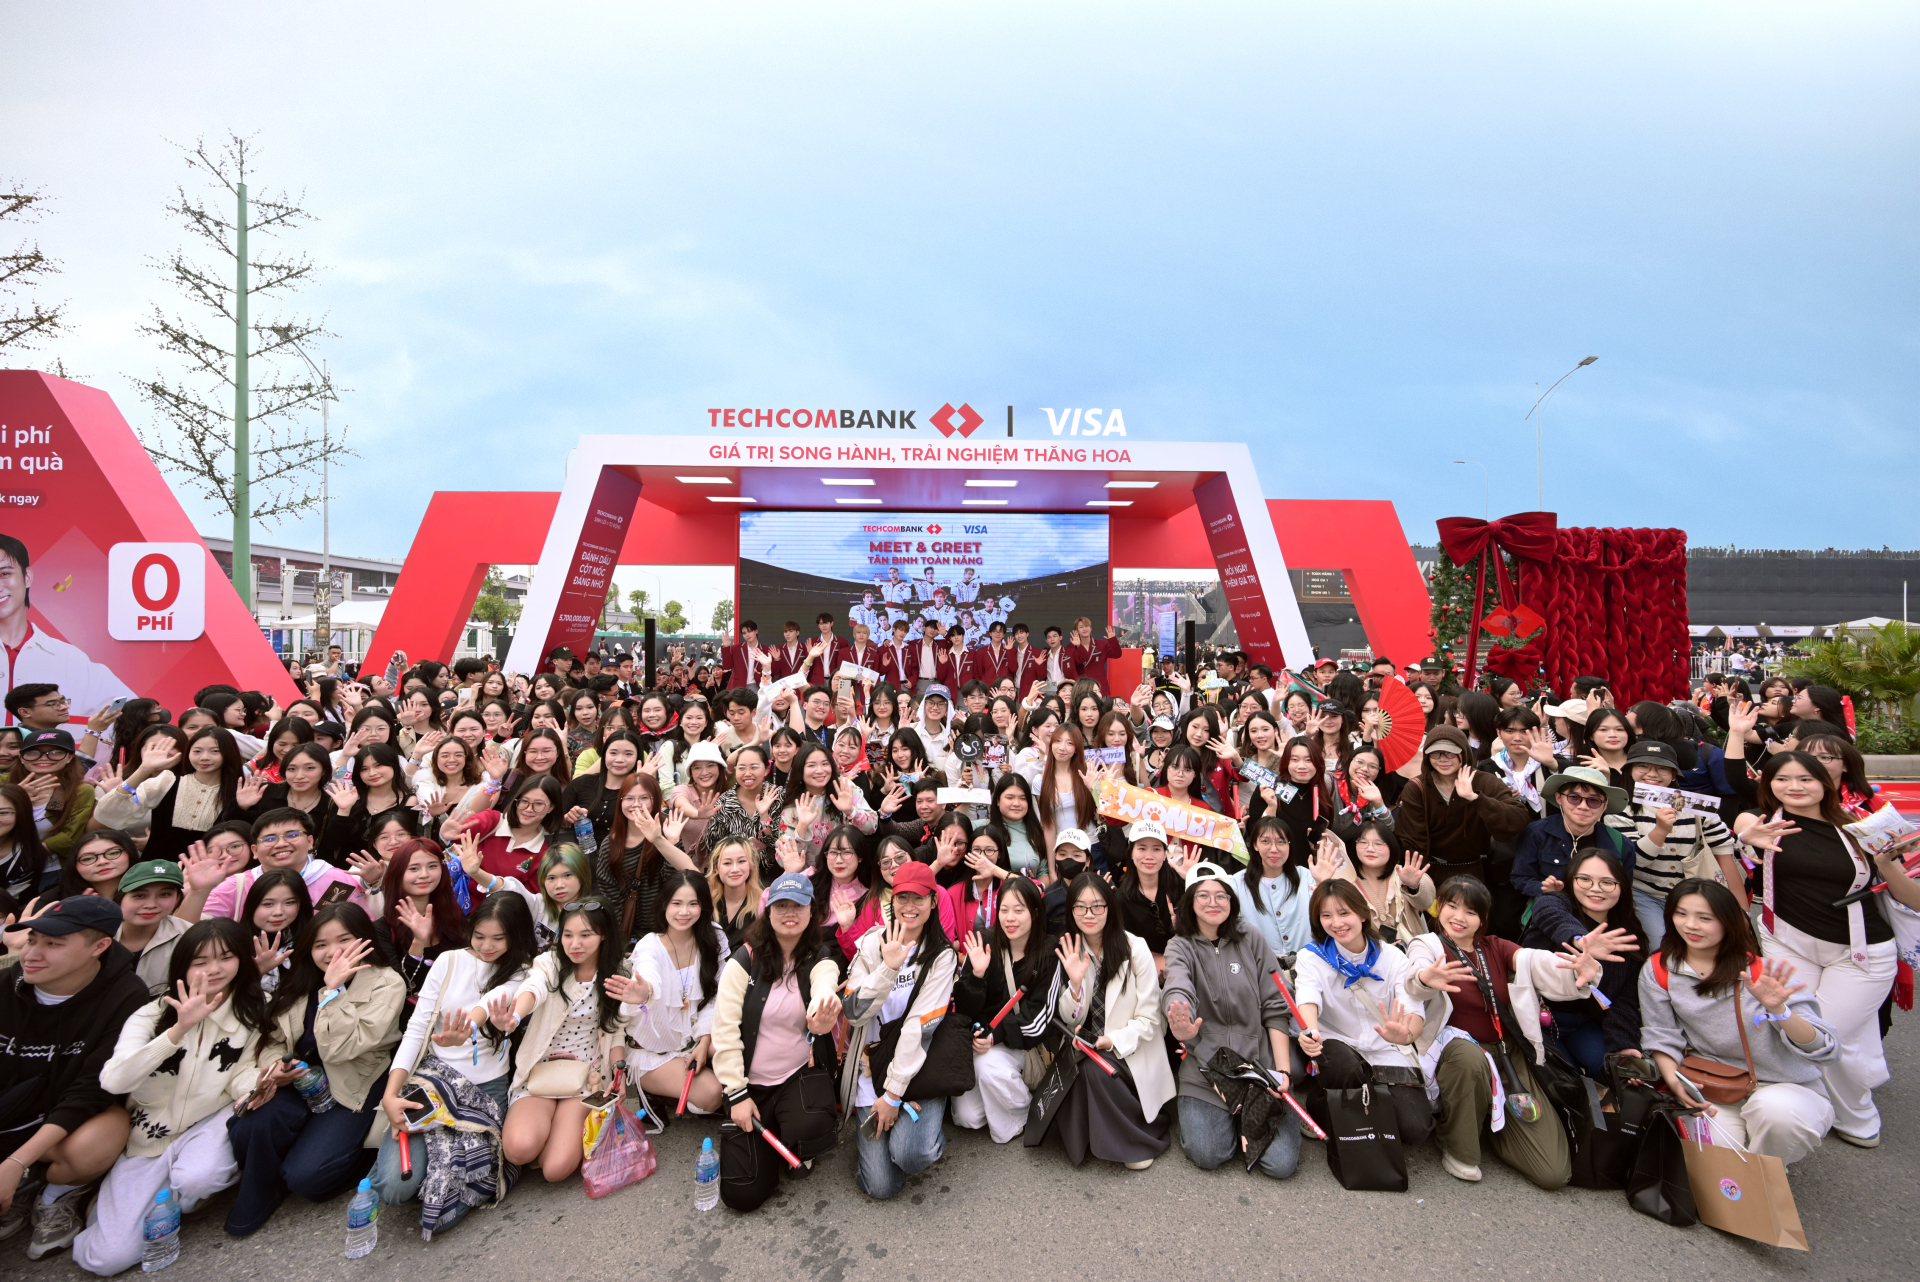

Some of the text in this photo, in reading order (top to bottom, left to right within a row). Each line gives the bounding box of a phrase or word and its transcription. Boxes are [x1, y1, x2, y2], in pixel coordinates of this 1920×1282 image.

[708, 408, 917, 429] TECHCOMBANK
[1039, 407, 1127, 437] VISA
[15, 425, 53, 448] phí
[709, 442, 1131, 465] GIÁ TRỊ SONG HÀNH, TRẢI NGHIỆM THĂNG HOA
[20, 451, 63, 475] quà
[9, 495, 39, 506] ngay
[863, 525, 923, 533] TECHCOMBANK
[962, 525, 988, 534] VISA
[869, 541, 983, 554] MEET & GREET
[581, 551, 599, 563] ĐÁNH
[868, 554, 984, 565] TÂN BINH TOÀN NĂNG
[579, 564, 606, 577] CỘT MỐC
[131, 553, 181, 611] 0
[573, 575, 591, 587] ĐÁNG
[1225, 576, 1239, 588] THÊM
[137, 612, 174, 630] PHÍ
